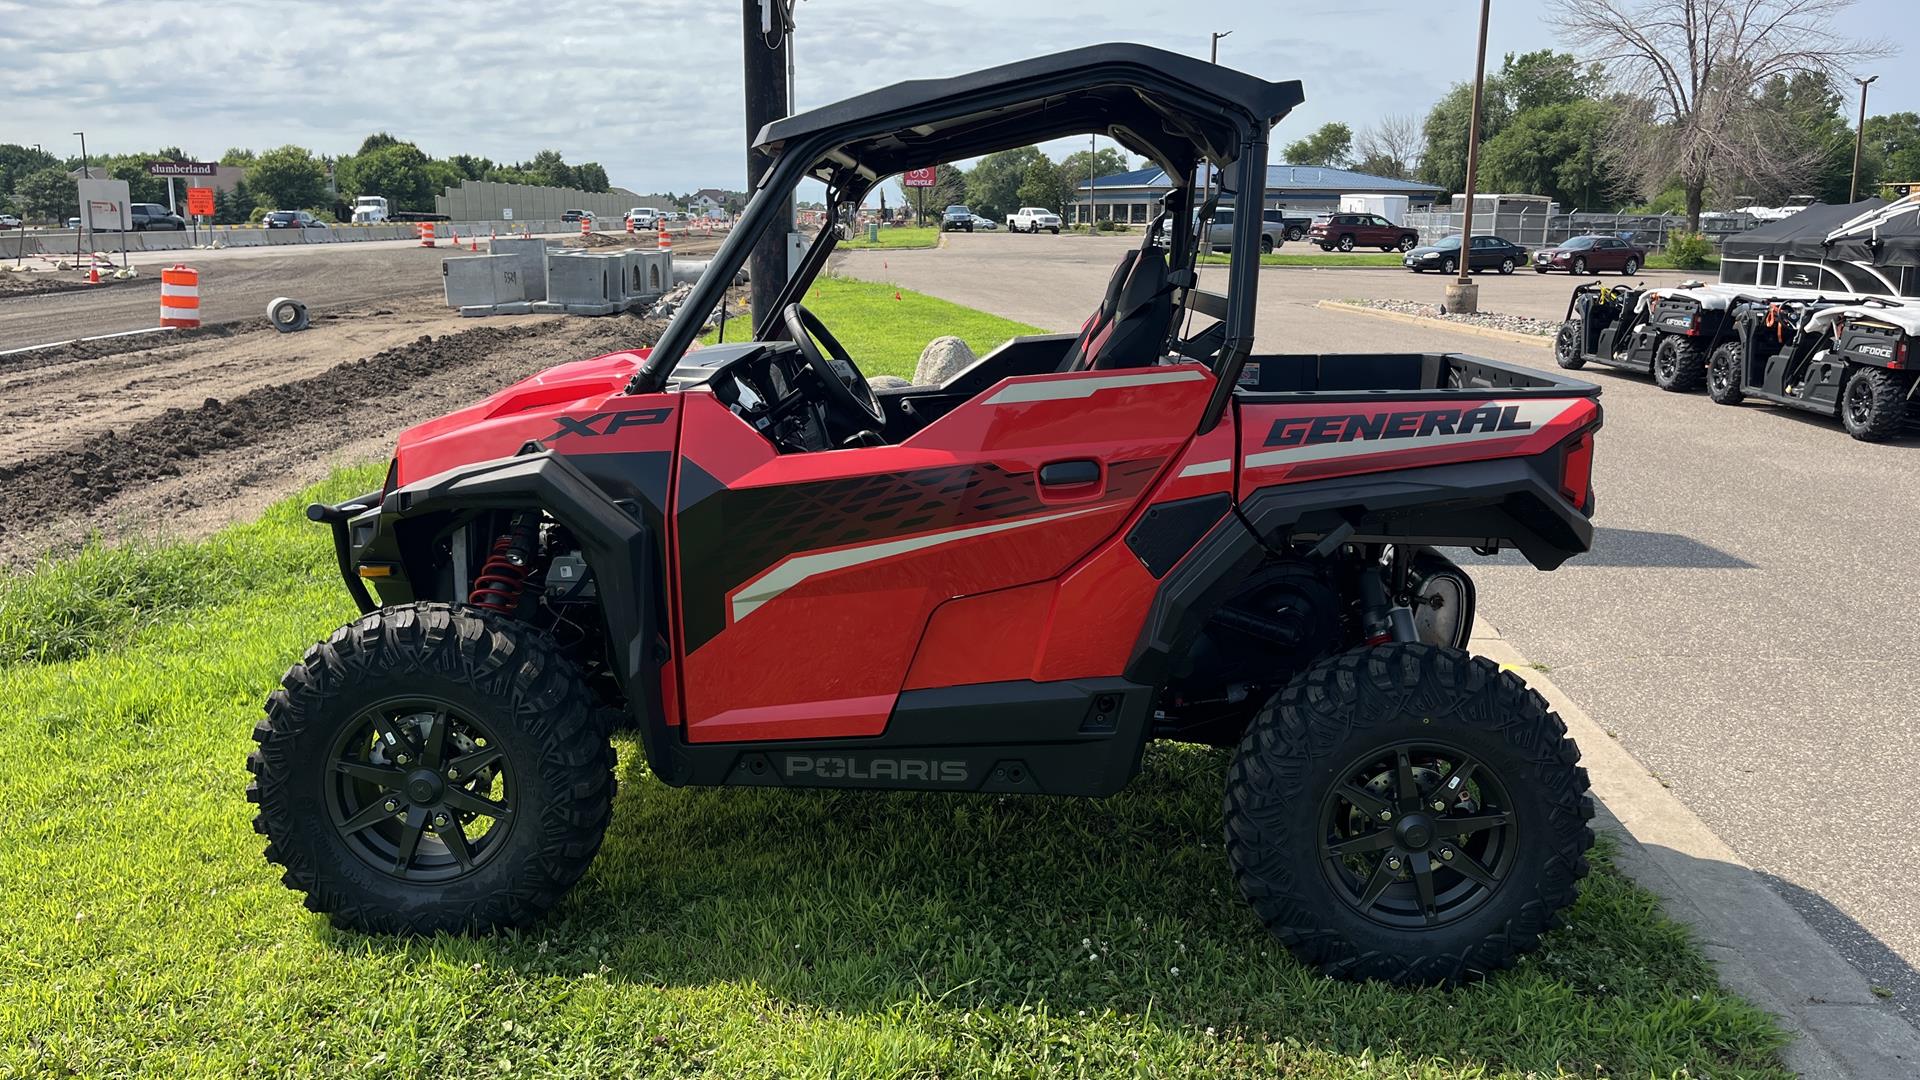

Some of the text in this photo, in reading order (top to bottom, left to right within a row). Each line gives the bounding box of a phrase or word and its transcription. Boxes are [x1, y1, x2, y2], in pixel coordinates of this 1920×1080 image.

[151, 163, 211, 174] slumberland
[1858, 345, 1892, 358] UFORCE
[541, 407, 674, 441] XP
[1263, 405, 1532, 446] GENERAL
[786, 756, 969, 782] POLARIS
